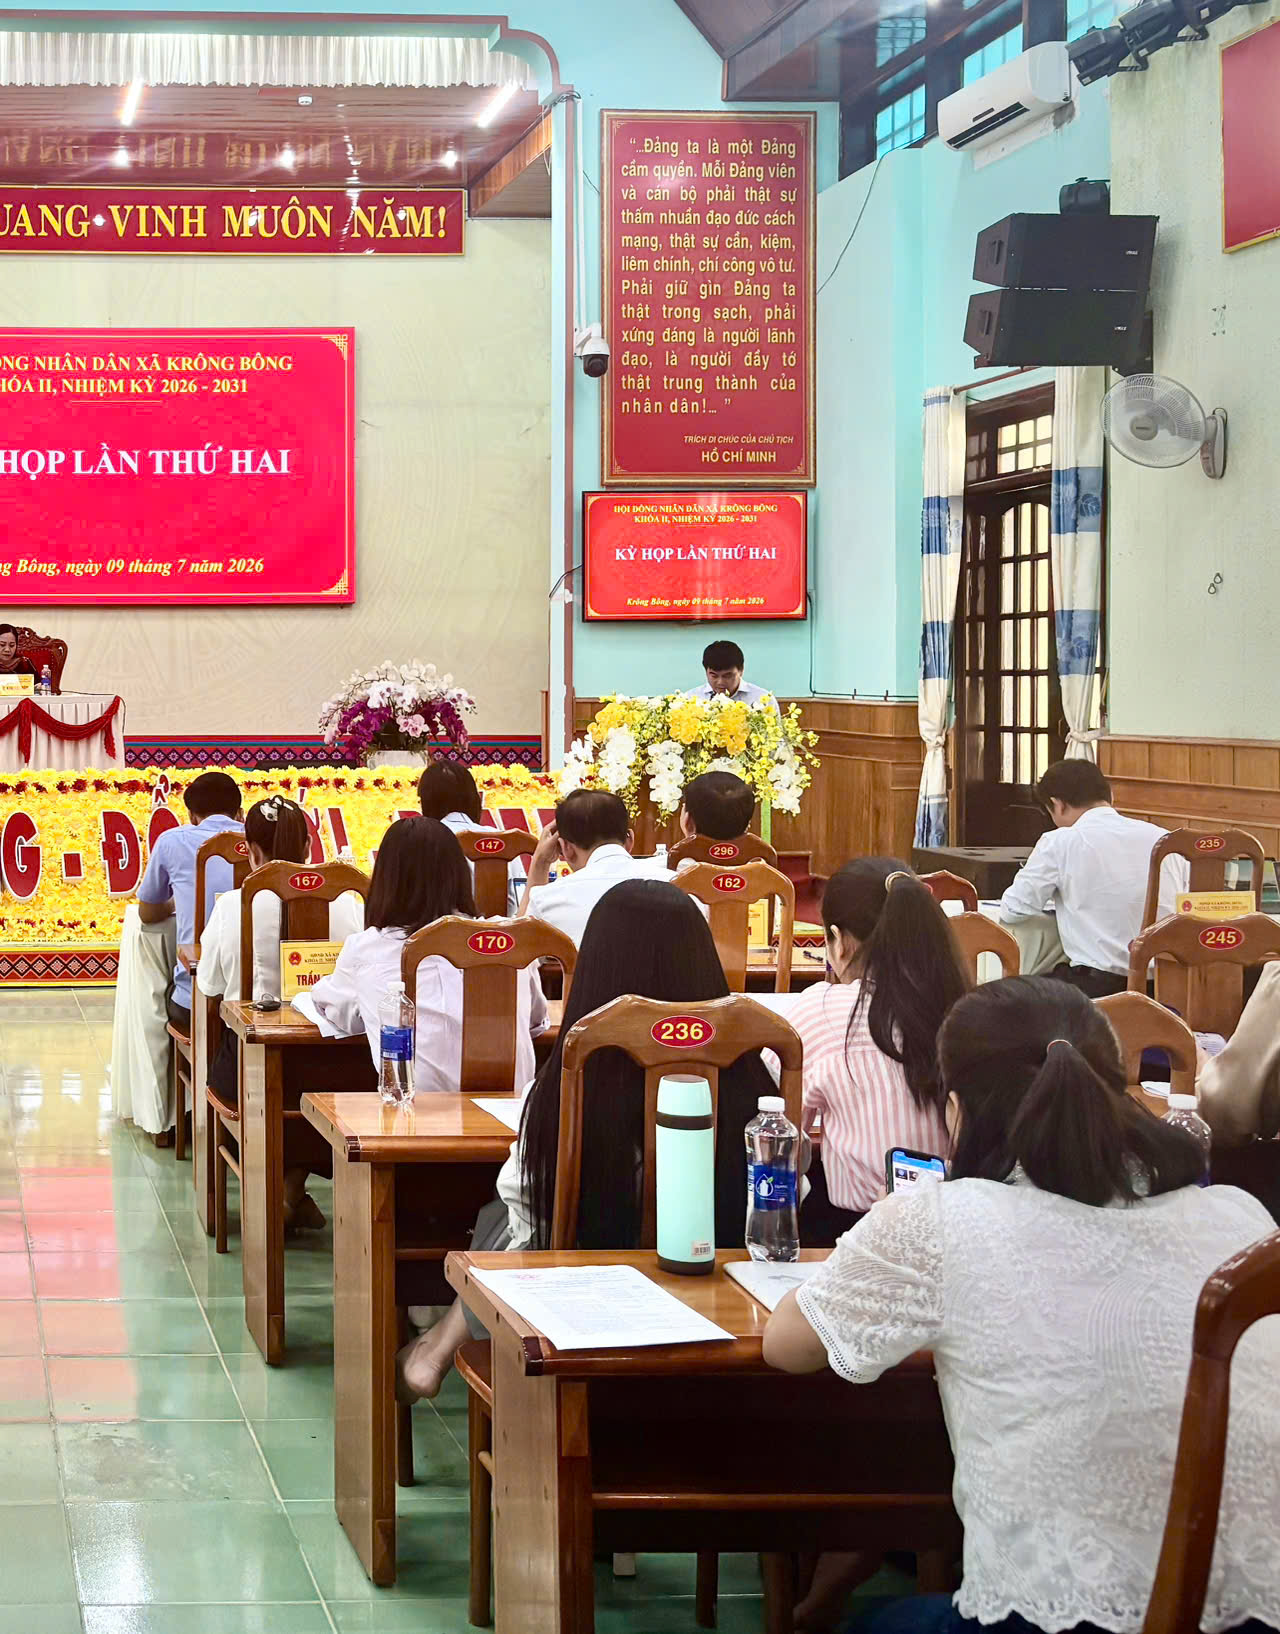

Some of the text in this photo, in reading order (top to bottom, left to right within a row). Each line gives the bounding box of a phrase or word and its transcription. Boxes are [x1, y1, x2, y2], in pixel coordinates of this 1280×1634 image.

[630, 136, 795, 157] “...Đảng ta là một Đảng
[622, 160, 795, 180] cầm quyền. Mỗi Đảng viên
[622, 184, 797, 204] và cán bộ phải thật sự
[108, 205, 207, 238] VINH
[223, 196, 332, 239] MUÔN
[352, 197, 447, 238] NĂM!
[621, 207, 795, 226] thấm nhuần đạo đức cách
[622, 231, 795, 251] mạng, thật sự cần, kiệm,
[622, 256, 795, 276] liêm chính, chí công vô tư.
[35, 352, 86, 370] NHÂN
[93, 352, 130, 370] DÂN
[136, 354, 161, 370] XÃ
[167, 352, 234, 370] KRÔNG
[240, 352, 292, 370] BÔNG
[39, 379, 57, 395] II,
[62, 377, 124, 396] NHIỆM
[130, 376, 156, 393] KỲ
[161, 379, 197, 392] 2026
[213, 379, 247, 392] 2031
[684, 435, 707, 443] TRÍCH
[718, 435, 739, 444] CHÚC
[741, 434, 756, 444] CỦA
[758, 434, 774, 444] CHỦ
[776, 436, 793, 445] TỊCH
[72, 443, 140, 474] LẦN
[149, 443, 223, 474] THỨ
[230, 450, 290, 474] HAI
[702, 447, 776, 462] HỒ CHÍ MINH
[616, 544, 776, 562] KỲ HỌP LẦN THỨ HAI
[16, 559, 60, 576] Bông,
[66, 559, 102, 576] ngày
[106, 559, 124, 573] 09
[128, 559, 172, 576] tháng
[178, 559, 186, 572] 7
[189, 560, 223, 572] năm
[227, 558, 264, 572] 2026
[480, 841, 500, 851] 147
[714, 846, 734, 856] 296
[1199, 839, 1220, 849] 235
[294, 875, 319, 886] 167
[717, 877, 741, 888] 162
[475, 936, 507, 949] 170
[1205, 931, 1237, 944] 245
[660, 1023, 704, 1040] 236
